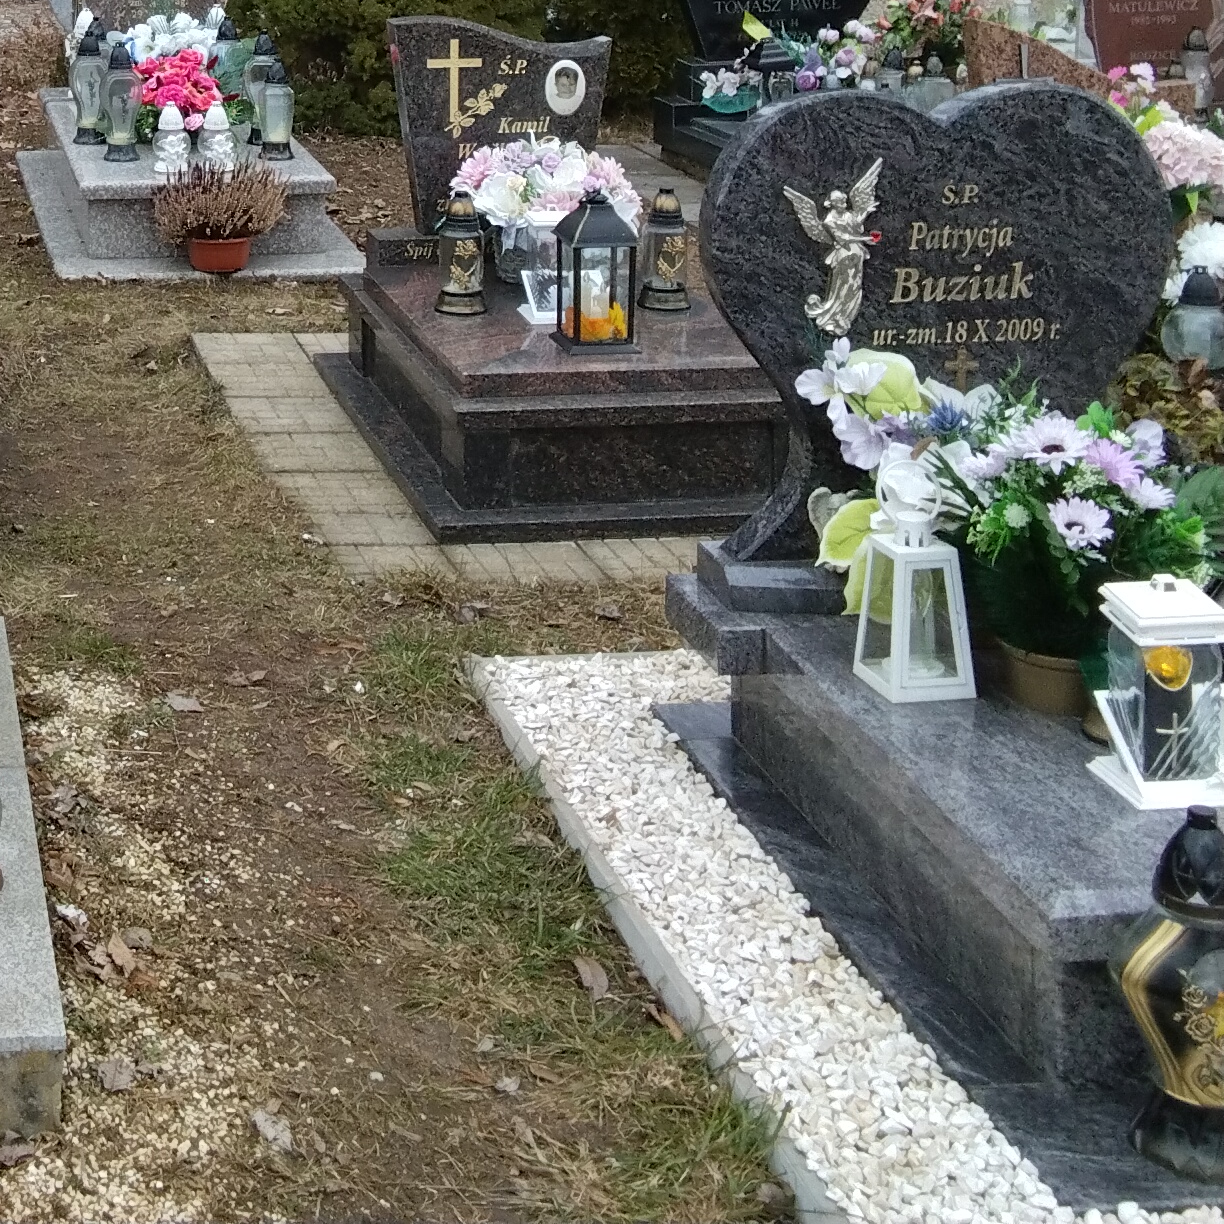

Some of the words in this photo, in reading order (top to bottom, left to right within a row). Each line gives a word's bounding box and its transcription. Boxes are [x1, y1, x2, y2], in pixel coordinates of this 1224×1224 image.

[1108, 0, 1199, 14] MATULEWICZ
[497, 54, 527, 75] Ś.P.
[497, 116, 550, 134] Kamil
[908, 218, 1014, 258] Patrycja
[889, 260, 1034, 305] Buziuk
[972, 319, 990, 343] X
[995, 317, 1046, 342] 2009
[1049, 322, 1062, 340] r.
